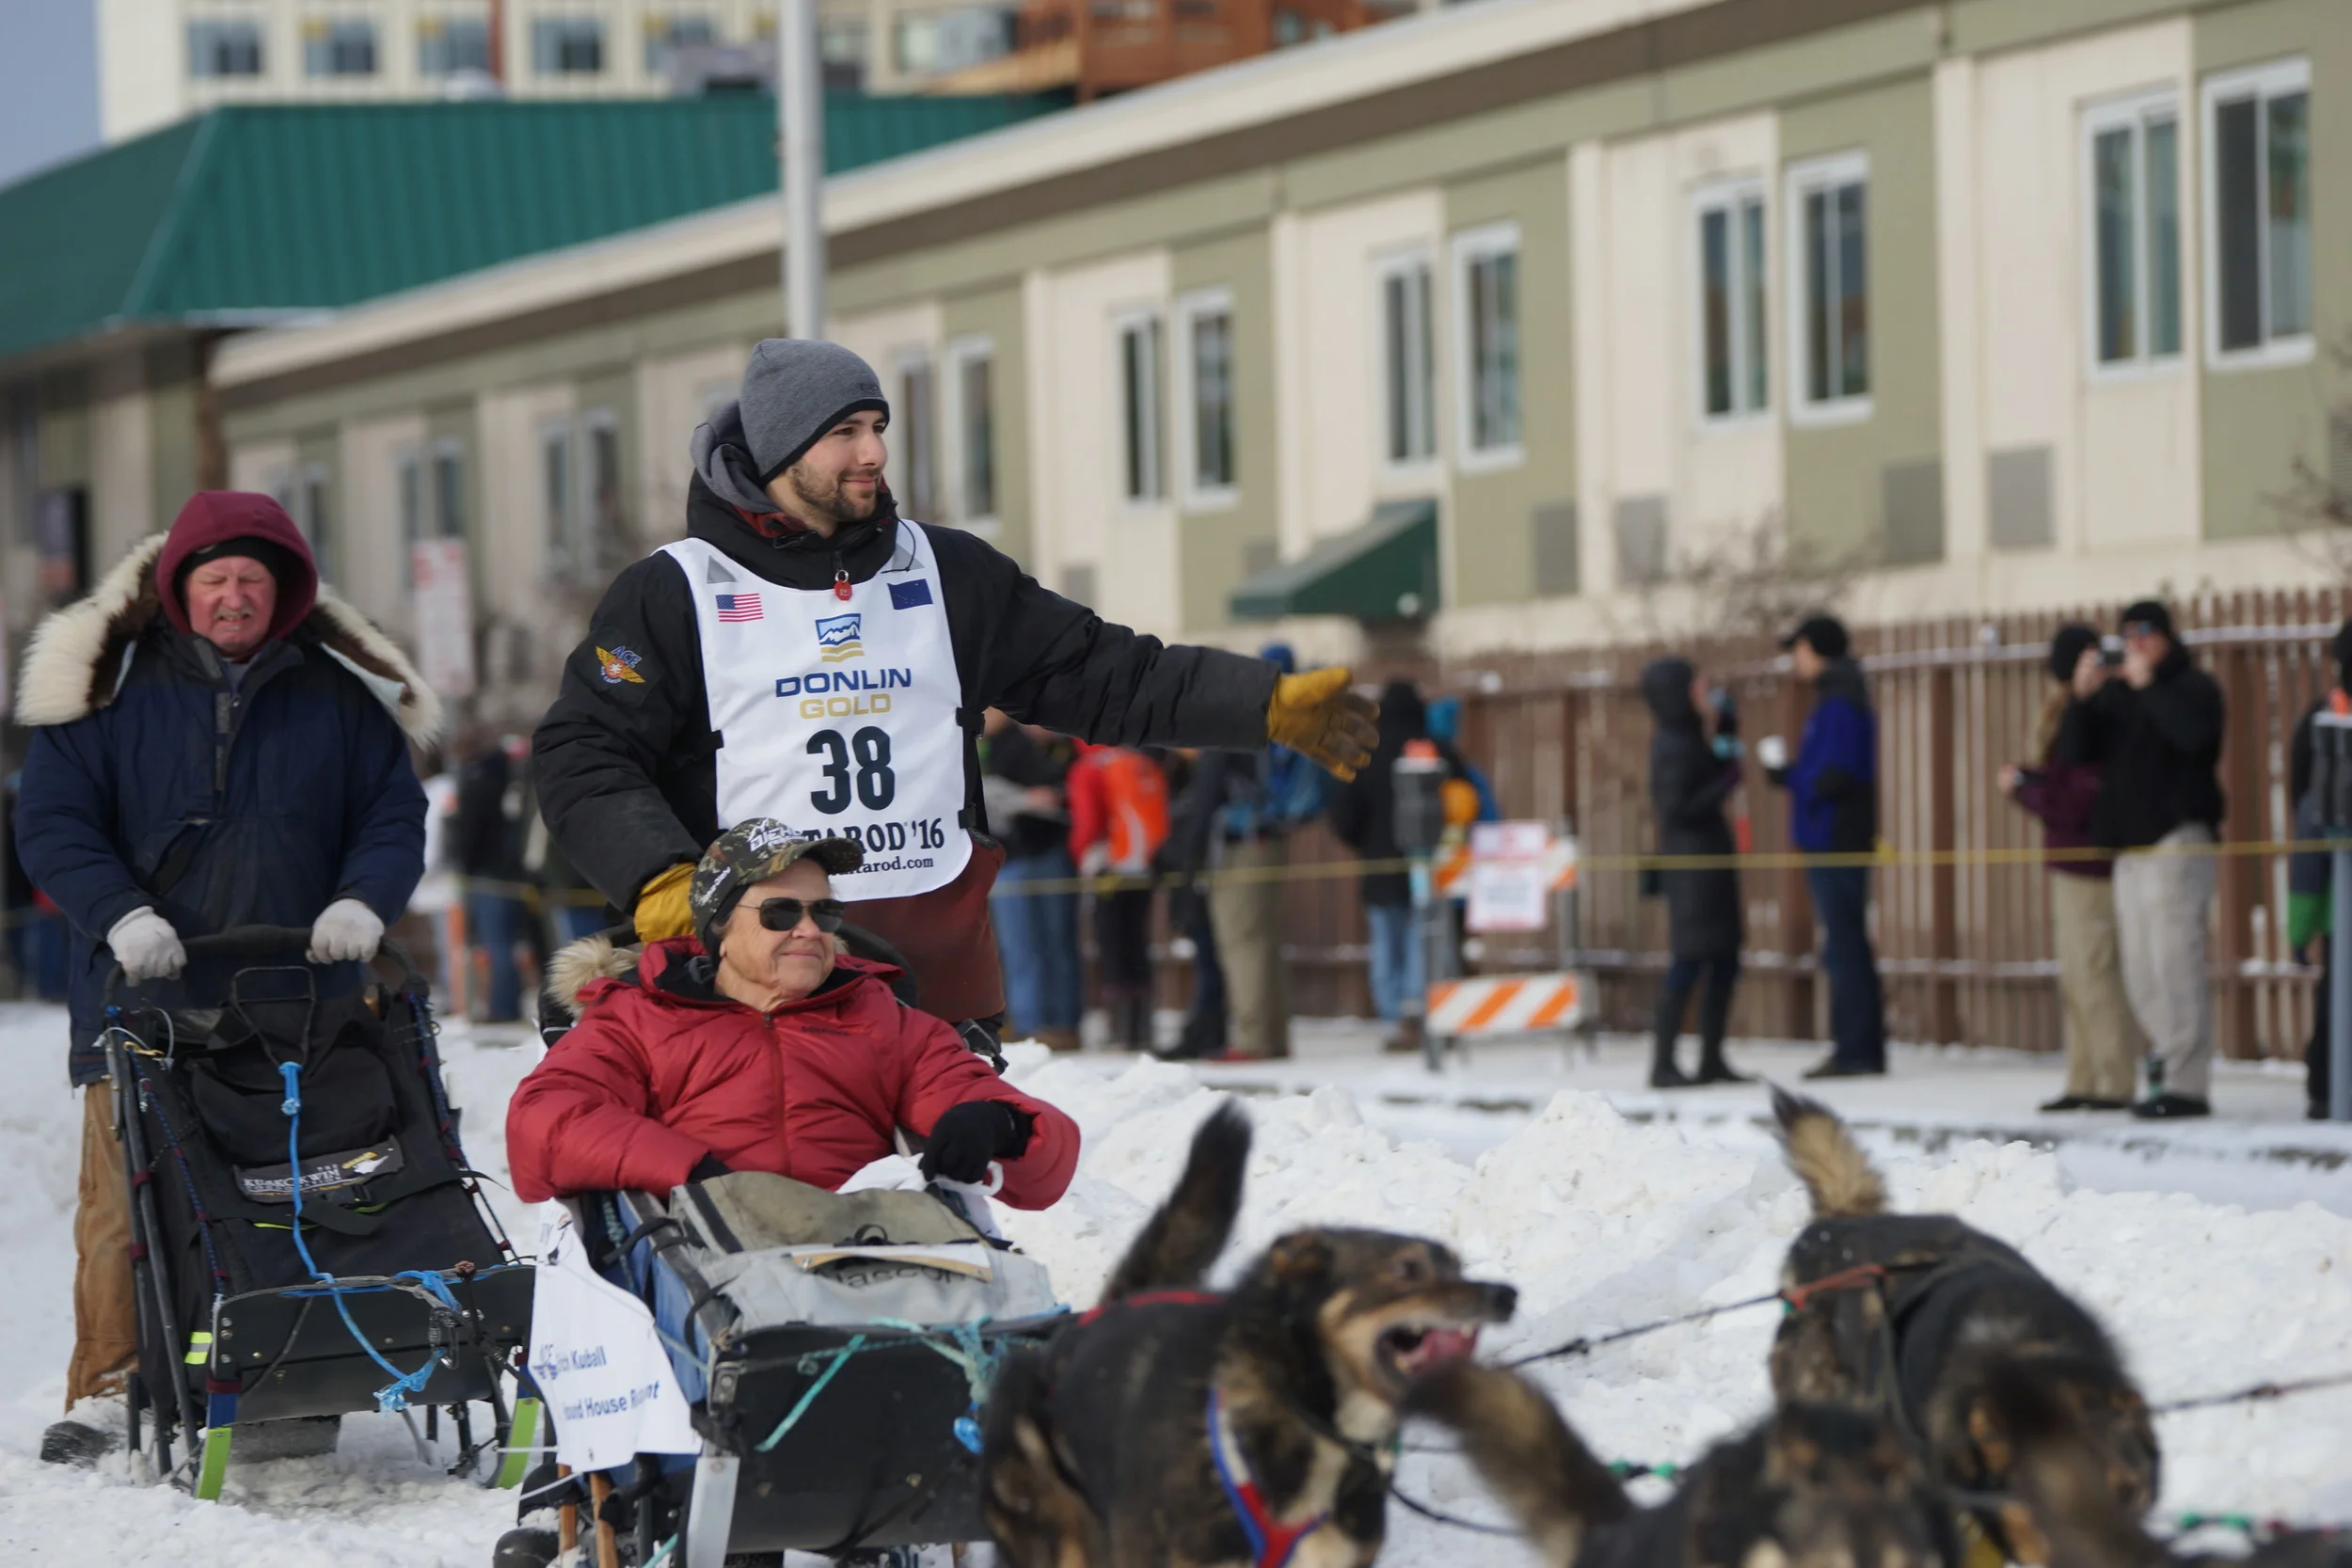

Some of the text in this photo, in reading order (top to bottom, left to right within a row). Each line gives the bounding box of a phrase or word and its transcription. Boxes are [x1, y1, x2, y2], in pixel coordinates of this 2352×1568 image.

[610, 645, 643, 669] ACE
[775, 668, 912, 697] DONLIN
[800, 694, 892, 719] GOLD
[806, 726, 896, 815] 38
[585, 1396, 628, 1418] House
